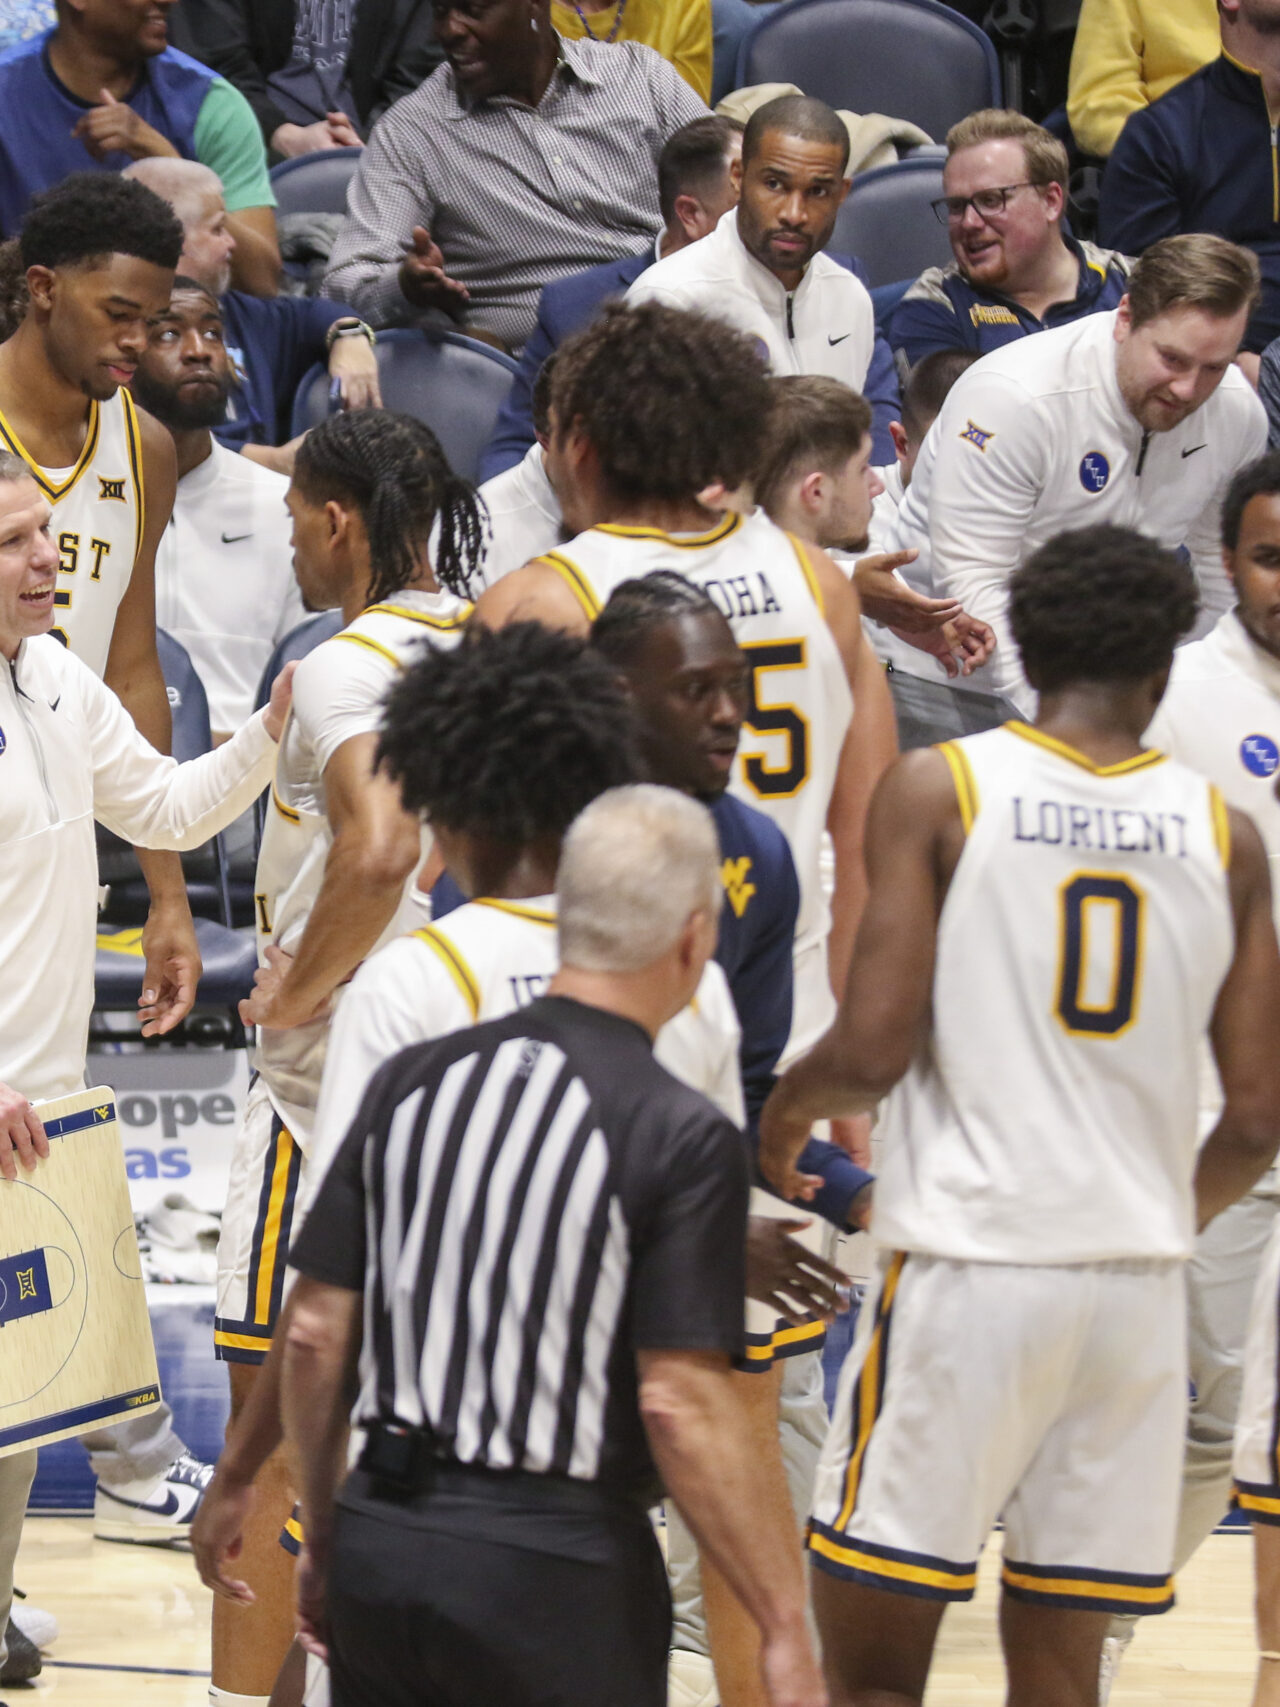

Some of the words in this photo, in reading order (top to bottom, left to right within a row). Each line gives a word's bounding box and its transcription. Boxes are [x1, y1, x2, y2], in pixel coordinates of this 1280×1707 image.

[58, 532, 111, 582] ST
[1012, 796, 1188, 858] LORIENT
[1050, 867, 1149, 1040] 0
[117, 1093, 236, 1138] ope
[124, 1146, 192, 1180] as
